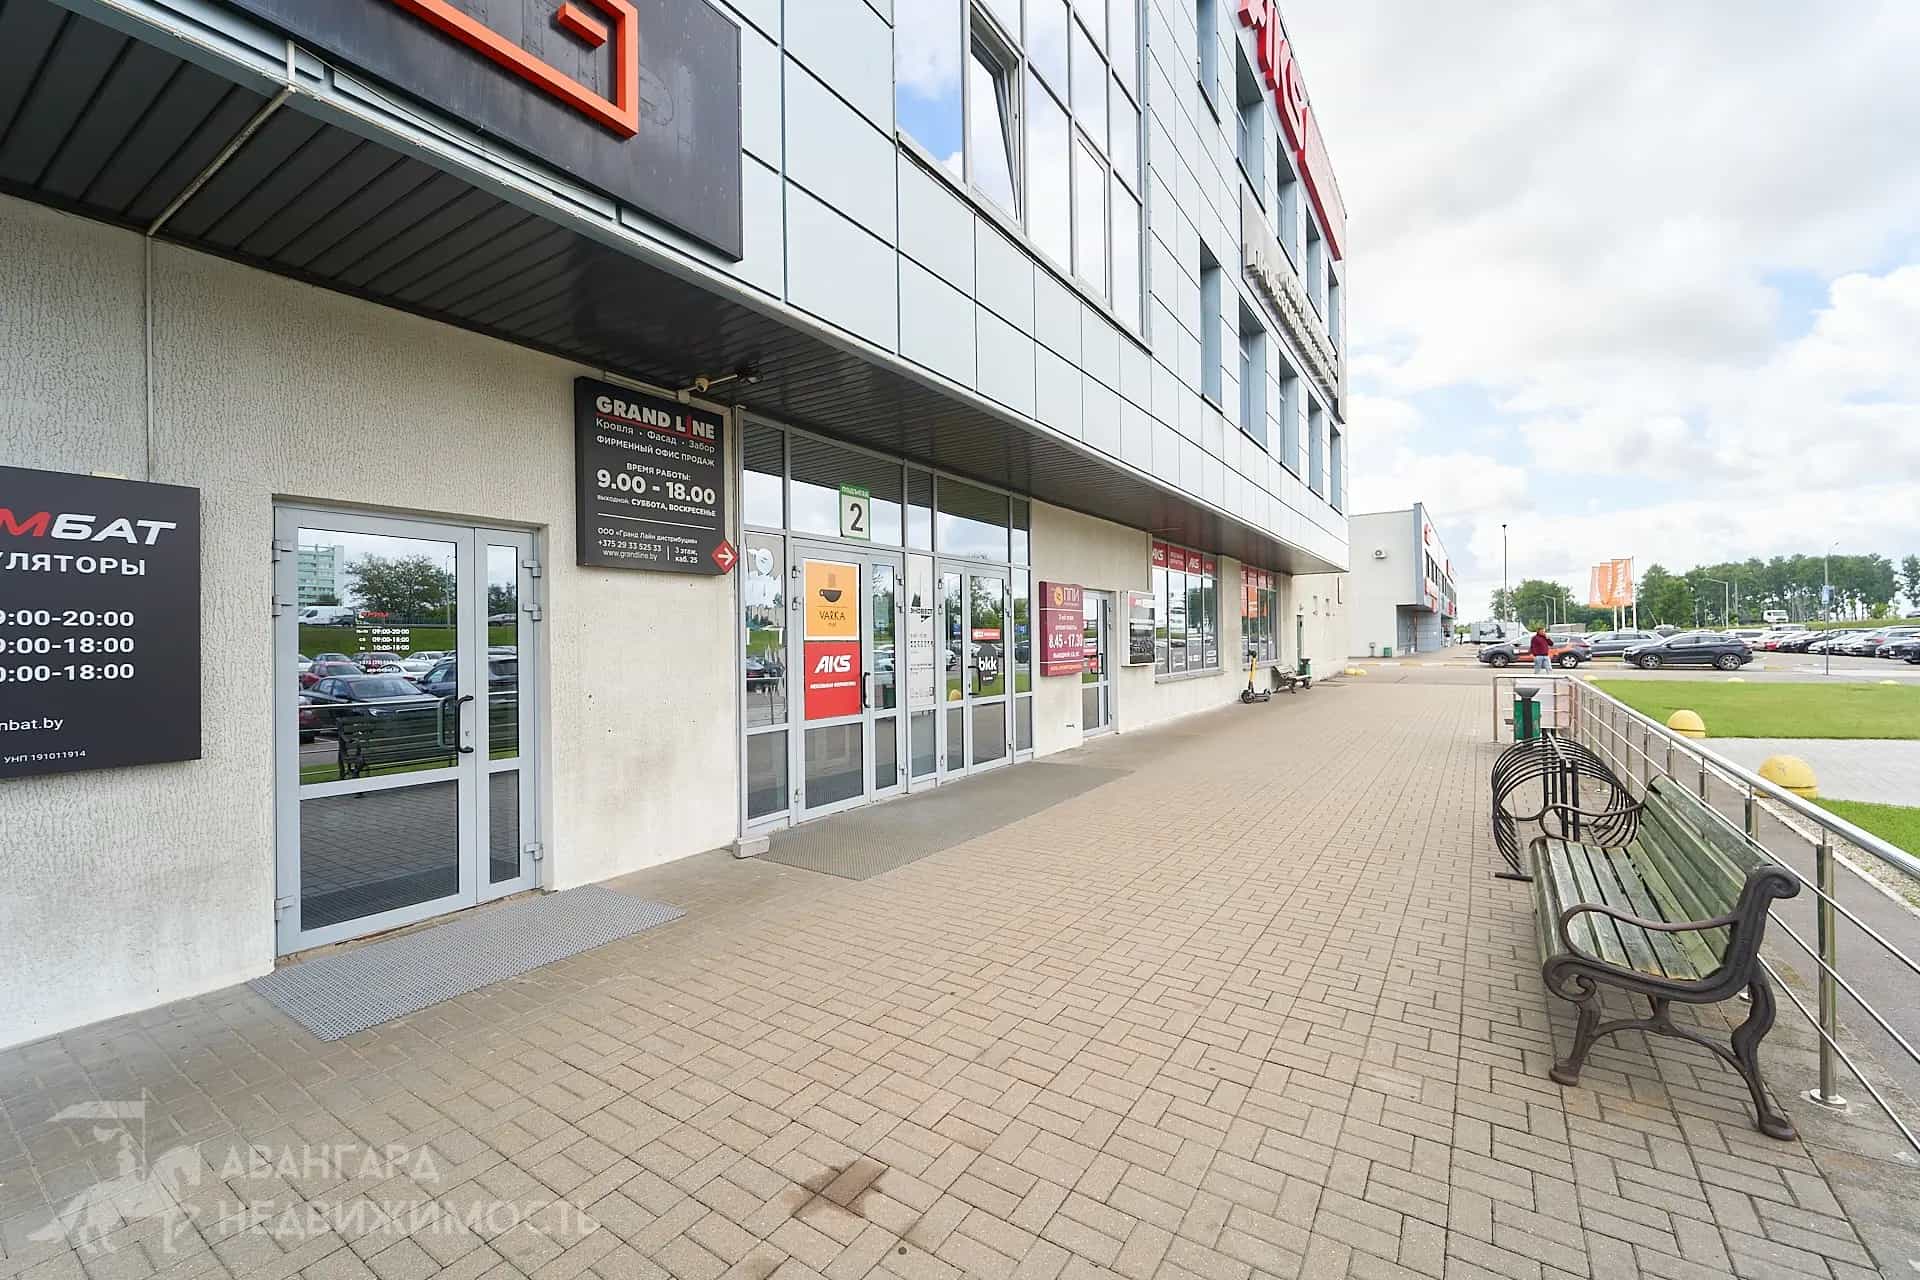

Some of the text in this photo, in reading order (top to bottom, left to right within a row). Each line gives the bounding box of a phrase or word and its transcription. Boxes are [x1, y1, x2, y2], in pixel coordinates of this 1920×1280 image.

[596, 395, 715, 440] GRAND LINE
[596, 418, 715, 454] Кровля Фасад Забор
[596, 435, 715, 467] ФИРМЕННЫЙ ОФИС ПРОДАЖ
[626, 462, 692, 481] ВРЕМЯ РАБОТЫ:
[596, 469, 646, 495] 9.00
[665, 481, 716, 505] 18.00
[631, 498, 668, 511] СУББОТА,
[850, 502, 863, 532] 2
[597, 527, 615, 536] ООО
[0, 552, 145, 576] ЛЯТОРЫ
[819, 610, 846, 621] VARKA
[813, 654, 852, 674] AKS
[3, 749, 86, 764] УНП 191011914
